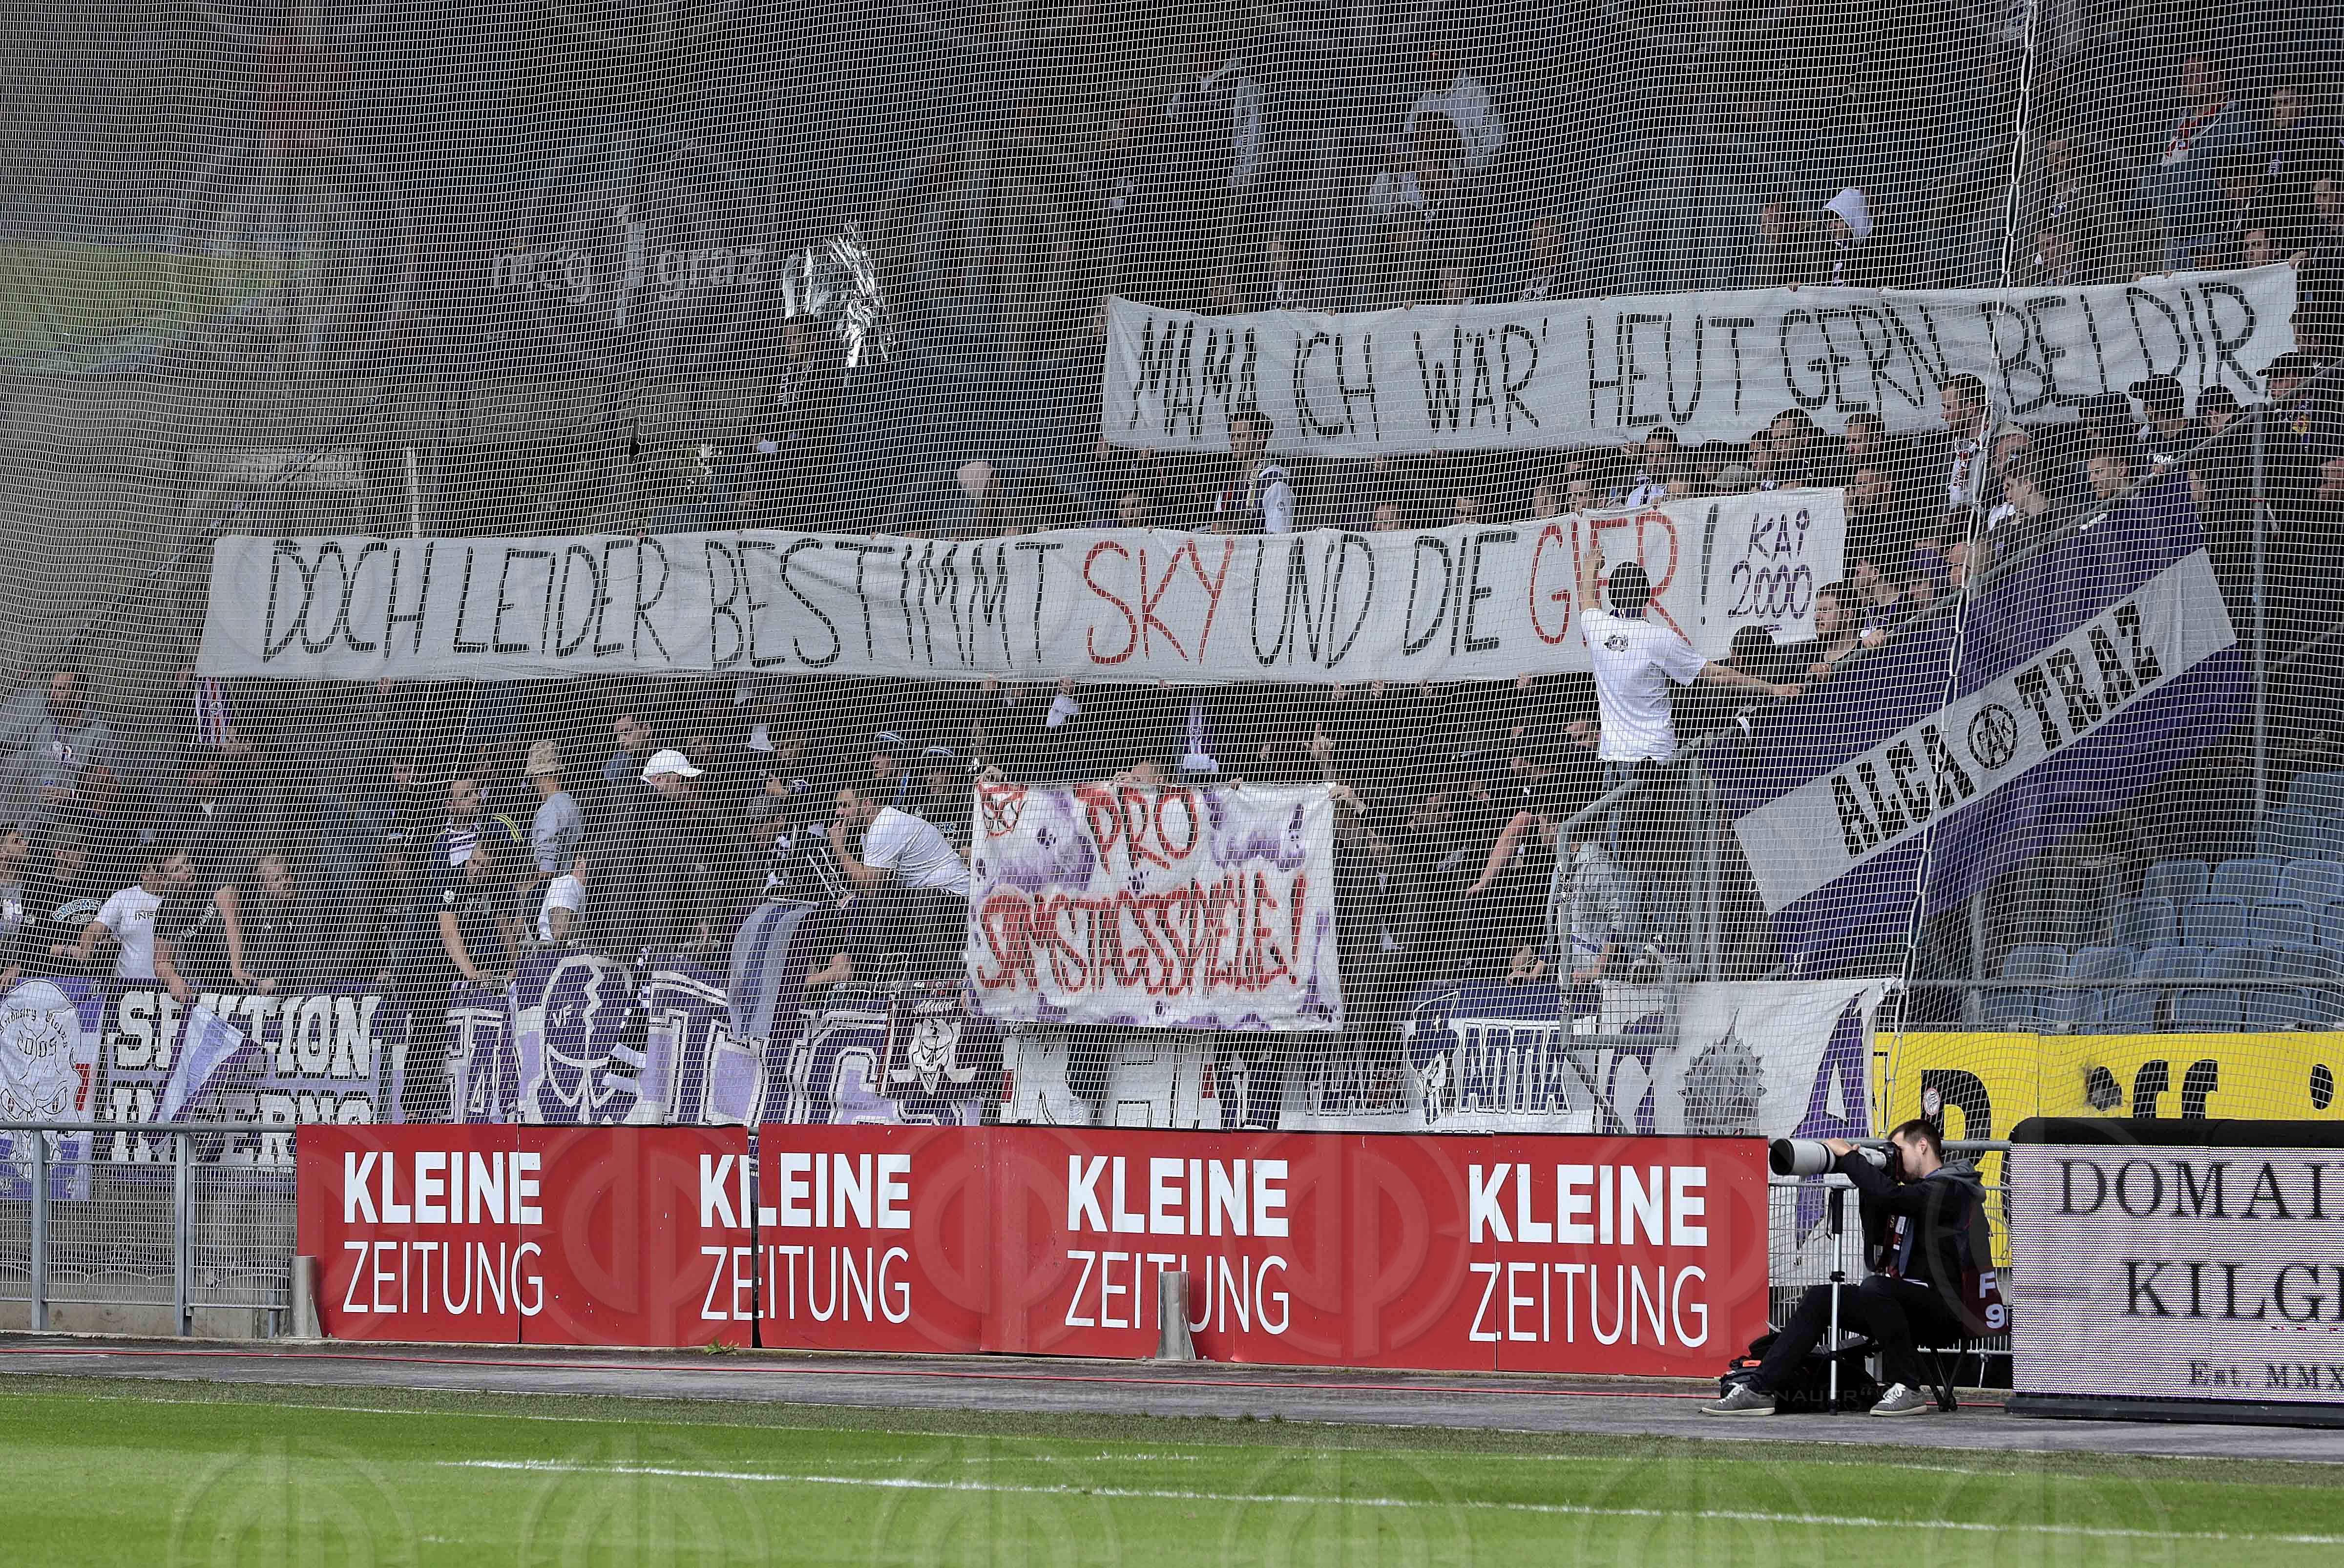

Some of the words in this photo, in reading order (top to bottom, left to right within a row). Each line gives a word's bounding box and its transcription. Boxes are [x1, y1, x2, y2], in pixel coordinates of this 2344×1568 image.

[656, 247, 765, 302] graz
[1294, 328, 1379, 440] ICH
[1587, 311, 1754, 430] HEUT
[1779, 302, 1948, 419] GERN
[1983, 293, 2107, 415] BEI
[2125, 280, 2268, 397] DIR
[263, 538, 435, 662] DOCH
[452, 536, 671, 661] LEIDER
[704, 537, 1064, 669] BESTIMMT
[1082, 538, 1235, 665] SKY
[1251, 533, 1375, 670] UND
[1402, 529, 1519, 658] DIE
[1727, 564, 1813, 620] 2000
[1075, 784, 1199, 874] PRO
[344, 1151, 543, 1224] KLEINE
[700, 1153, 911, 1229] KLEINE
[1067, 1155, 1289, 1237] KLEINE
[1468, 1163, 1708, 1247] KLEINE
[2056, 1158, 2344, 1220] DOMAI
[343, 1241, 543, 1316] ZEITUNG
[701, 1246, 910, 1323] ZEITUNG
[1469, 1262, 1708, 1348] ZEITUNG
[2120, 1261, 2344, 1322] KILG
